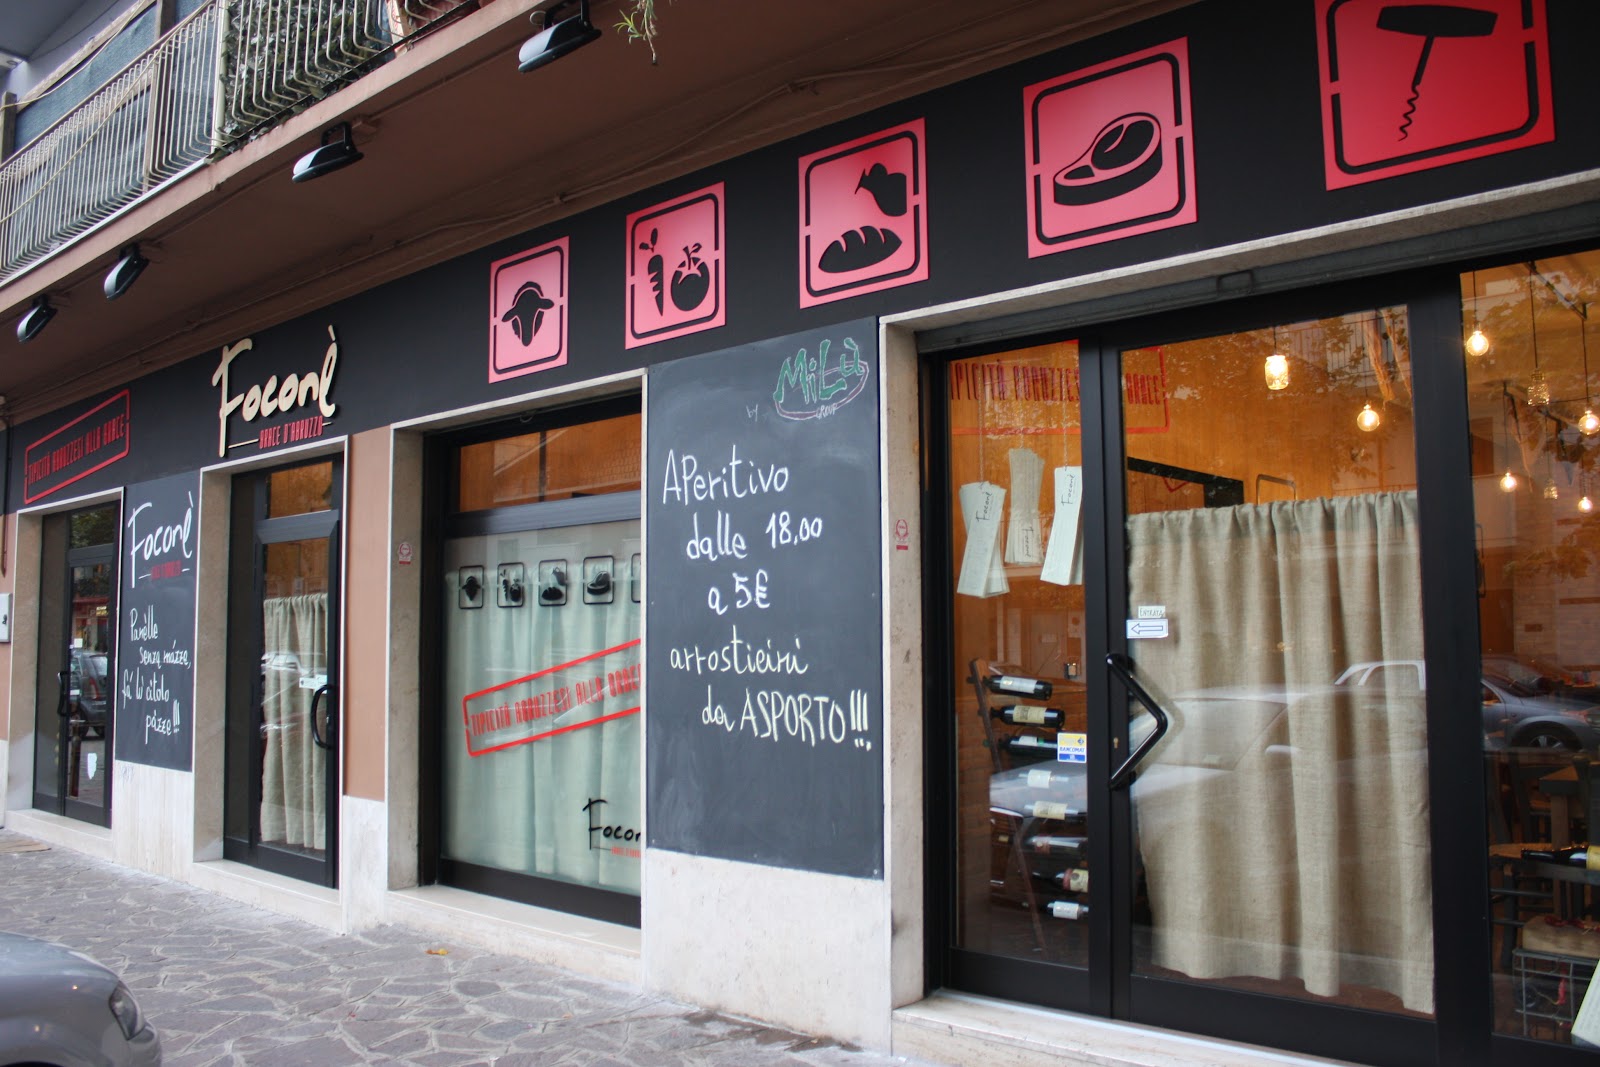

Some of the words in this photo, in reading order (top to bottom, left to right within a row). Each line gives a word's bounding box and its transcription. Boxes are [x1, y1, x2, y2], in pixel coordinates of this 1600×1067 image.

[950, 359, 1006, 401] IPICITÀ
[1013, 365, 1080, 402] ABRUZZES
[259, 426, 280, 449] BRACE
[686, 509, 748, 562] dalle
[707, 586, 729, 615] a
[732, 568, 771, 609] 5€
[701, 685, 735, 732] da
